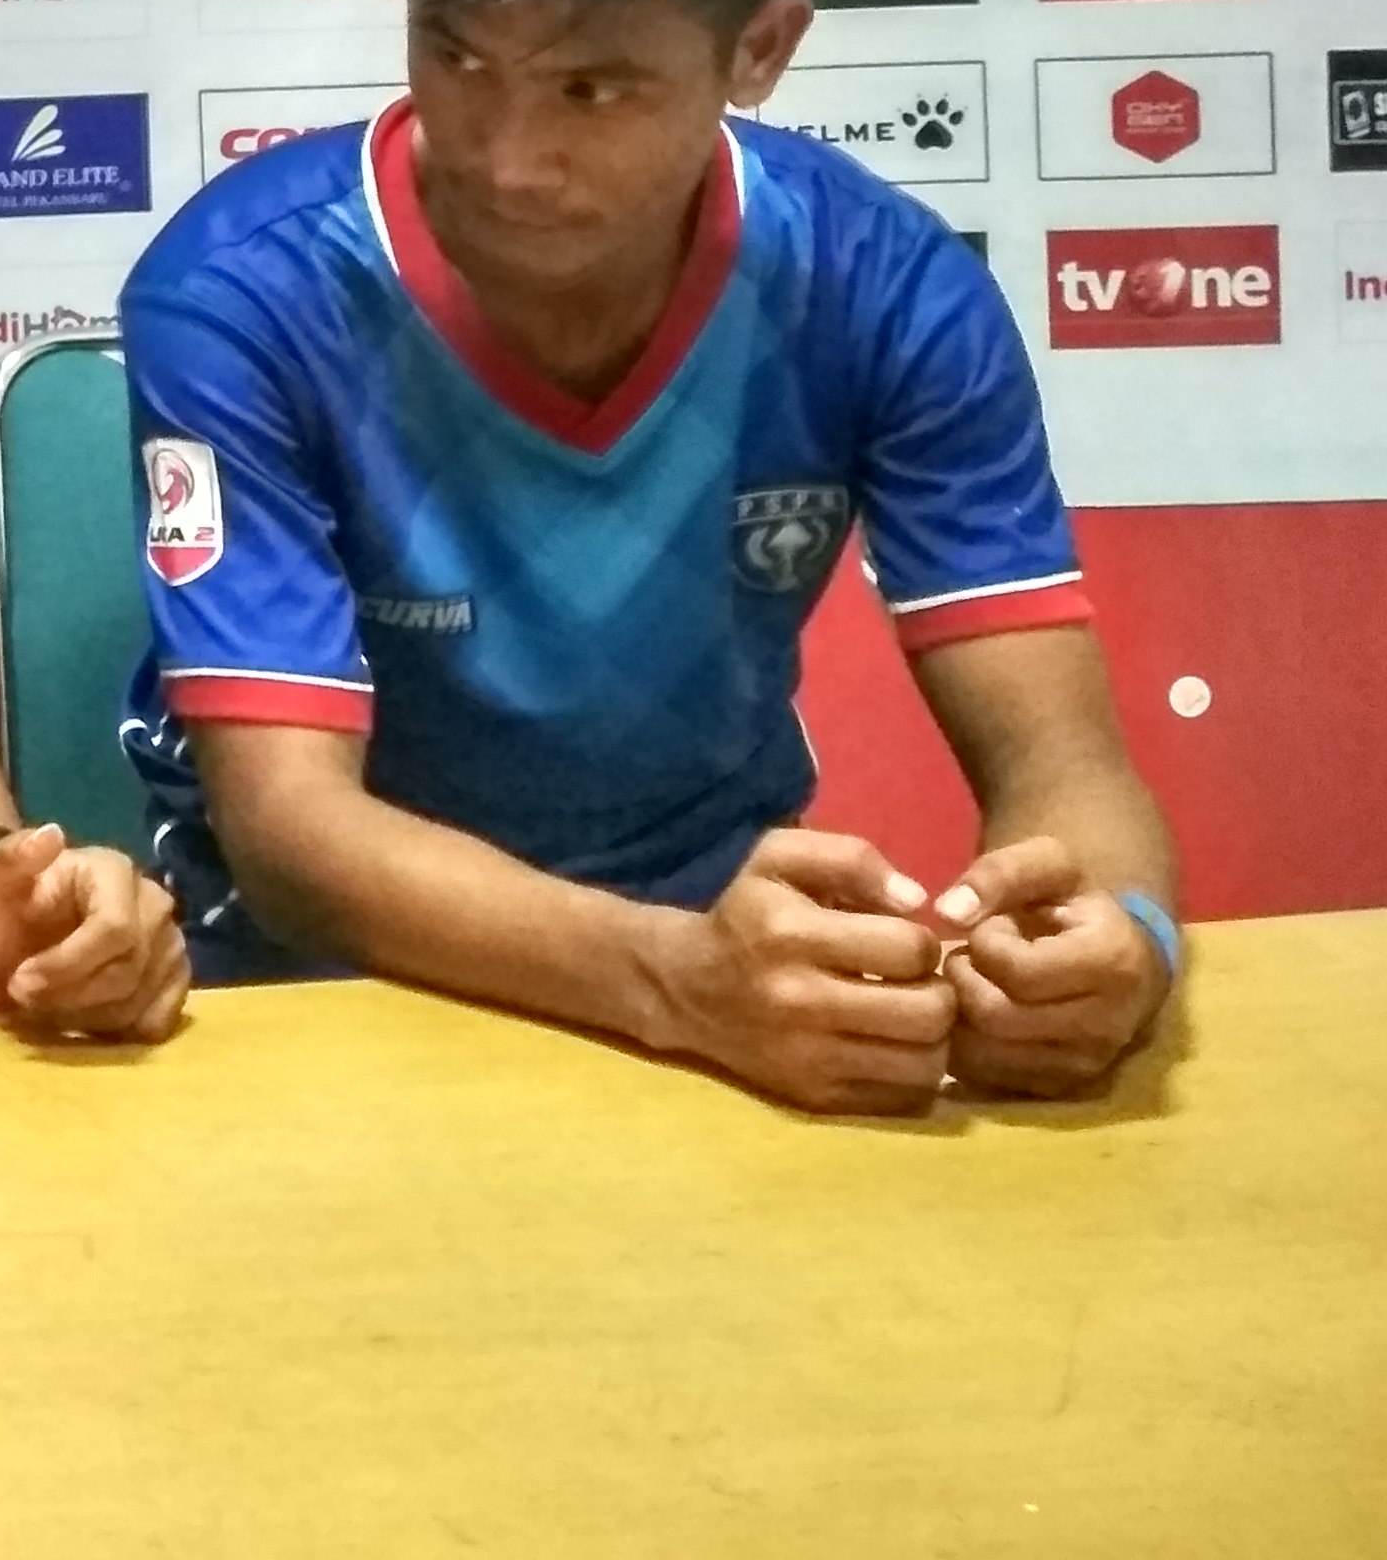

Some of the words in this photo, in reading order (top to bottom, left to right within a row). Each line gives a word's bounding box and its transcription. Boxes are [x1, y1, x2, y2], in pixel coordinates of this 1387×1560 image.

[52, 166, 120, 186] ELITE
[1058, 254, 1270, 313] tvOne
[194, 526, 216, 541] 2
